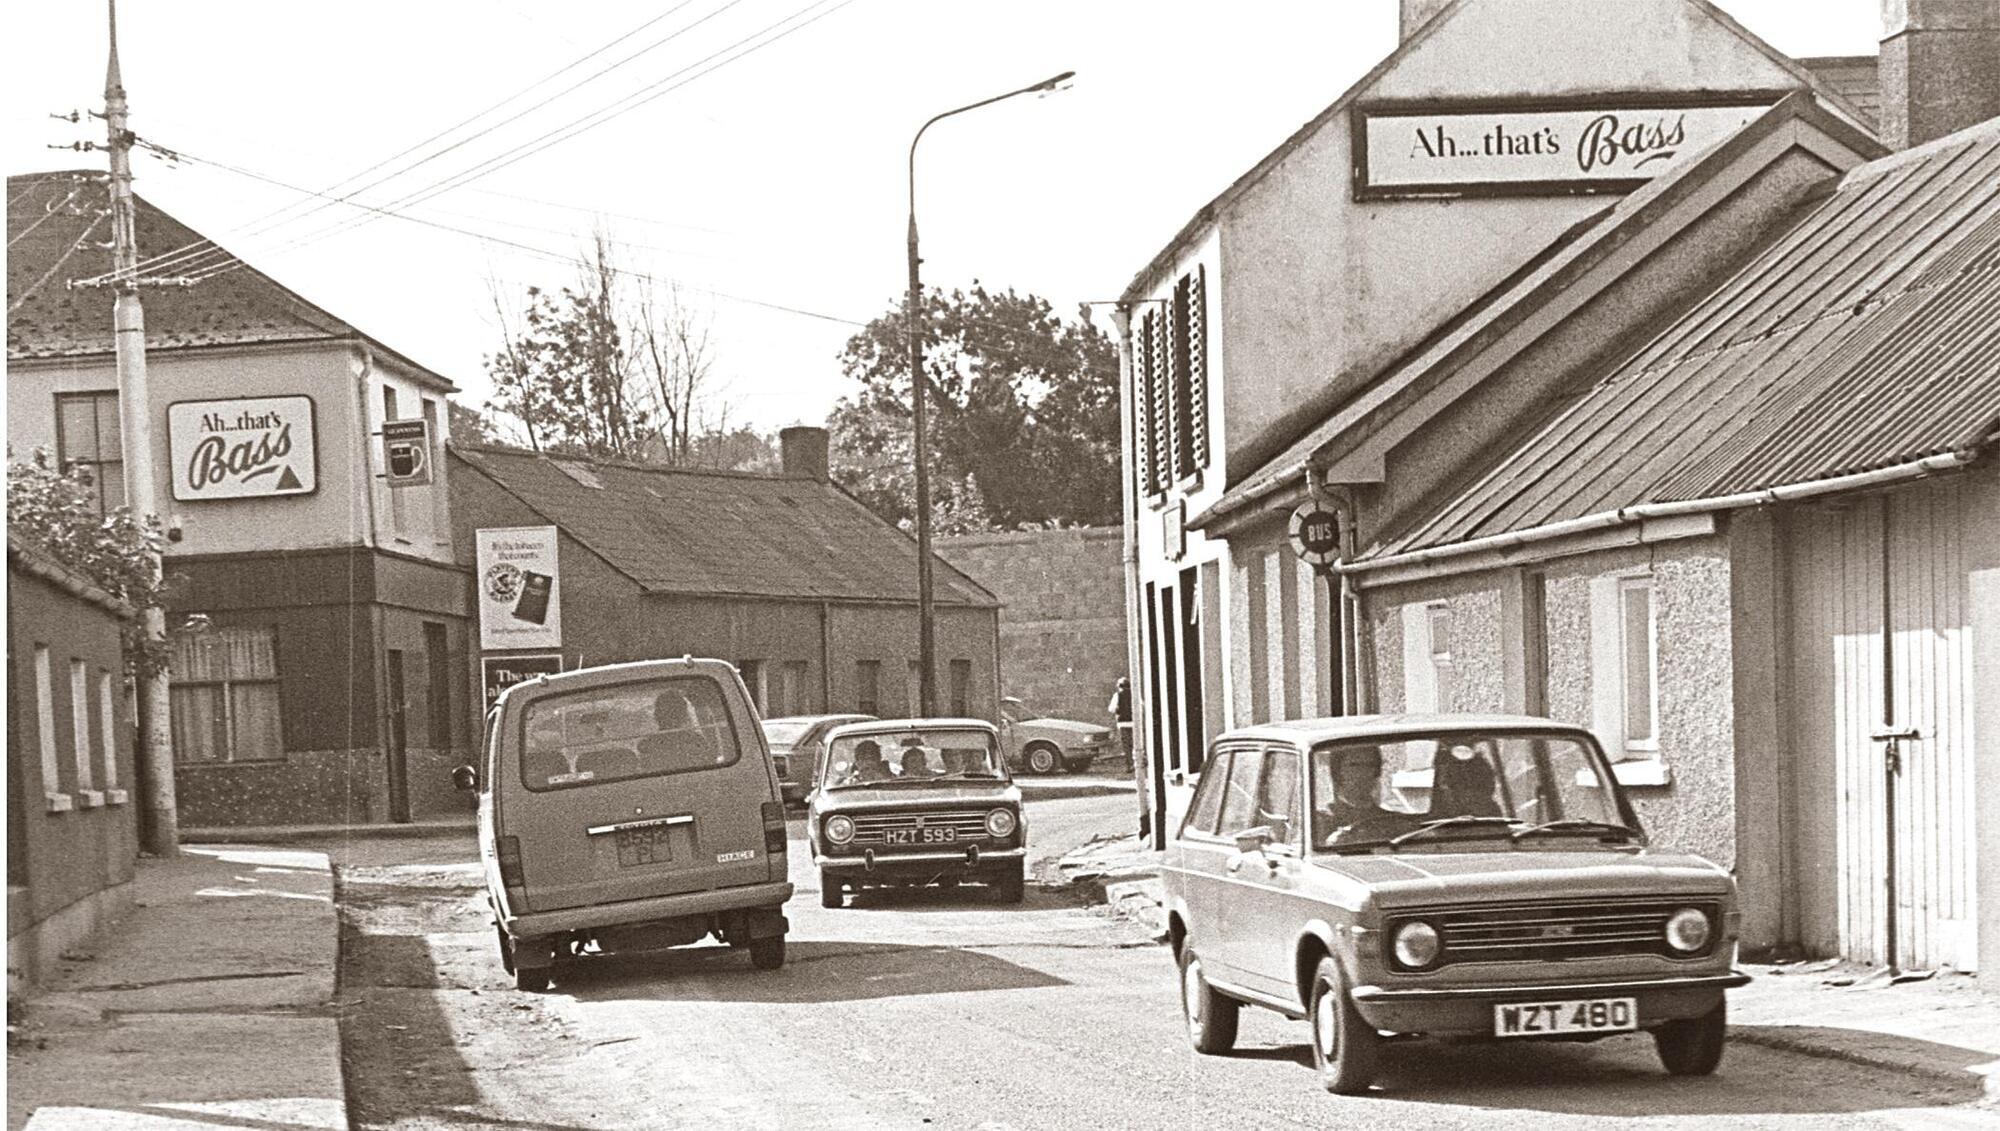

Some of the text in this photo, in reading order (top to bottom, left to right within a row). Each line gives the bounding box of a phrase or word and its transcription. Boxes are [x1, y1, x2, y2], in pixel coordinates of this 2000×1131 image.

[1577, 114, 1686, 173] Bass
[188, 423, 292, 491] Bass
[1307, 523, 1332, 542] BUS
[495, 669, 523, 683] The
[886, 828, 956, 844] HZT 593
[1502, 1001, 1629, 1033] WZT 480
